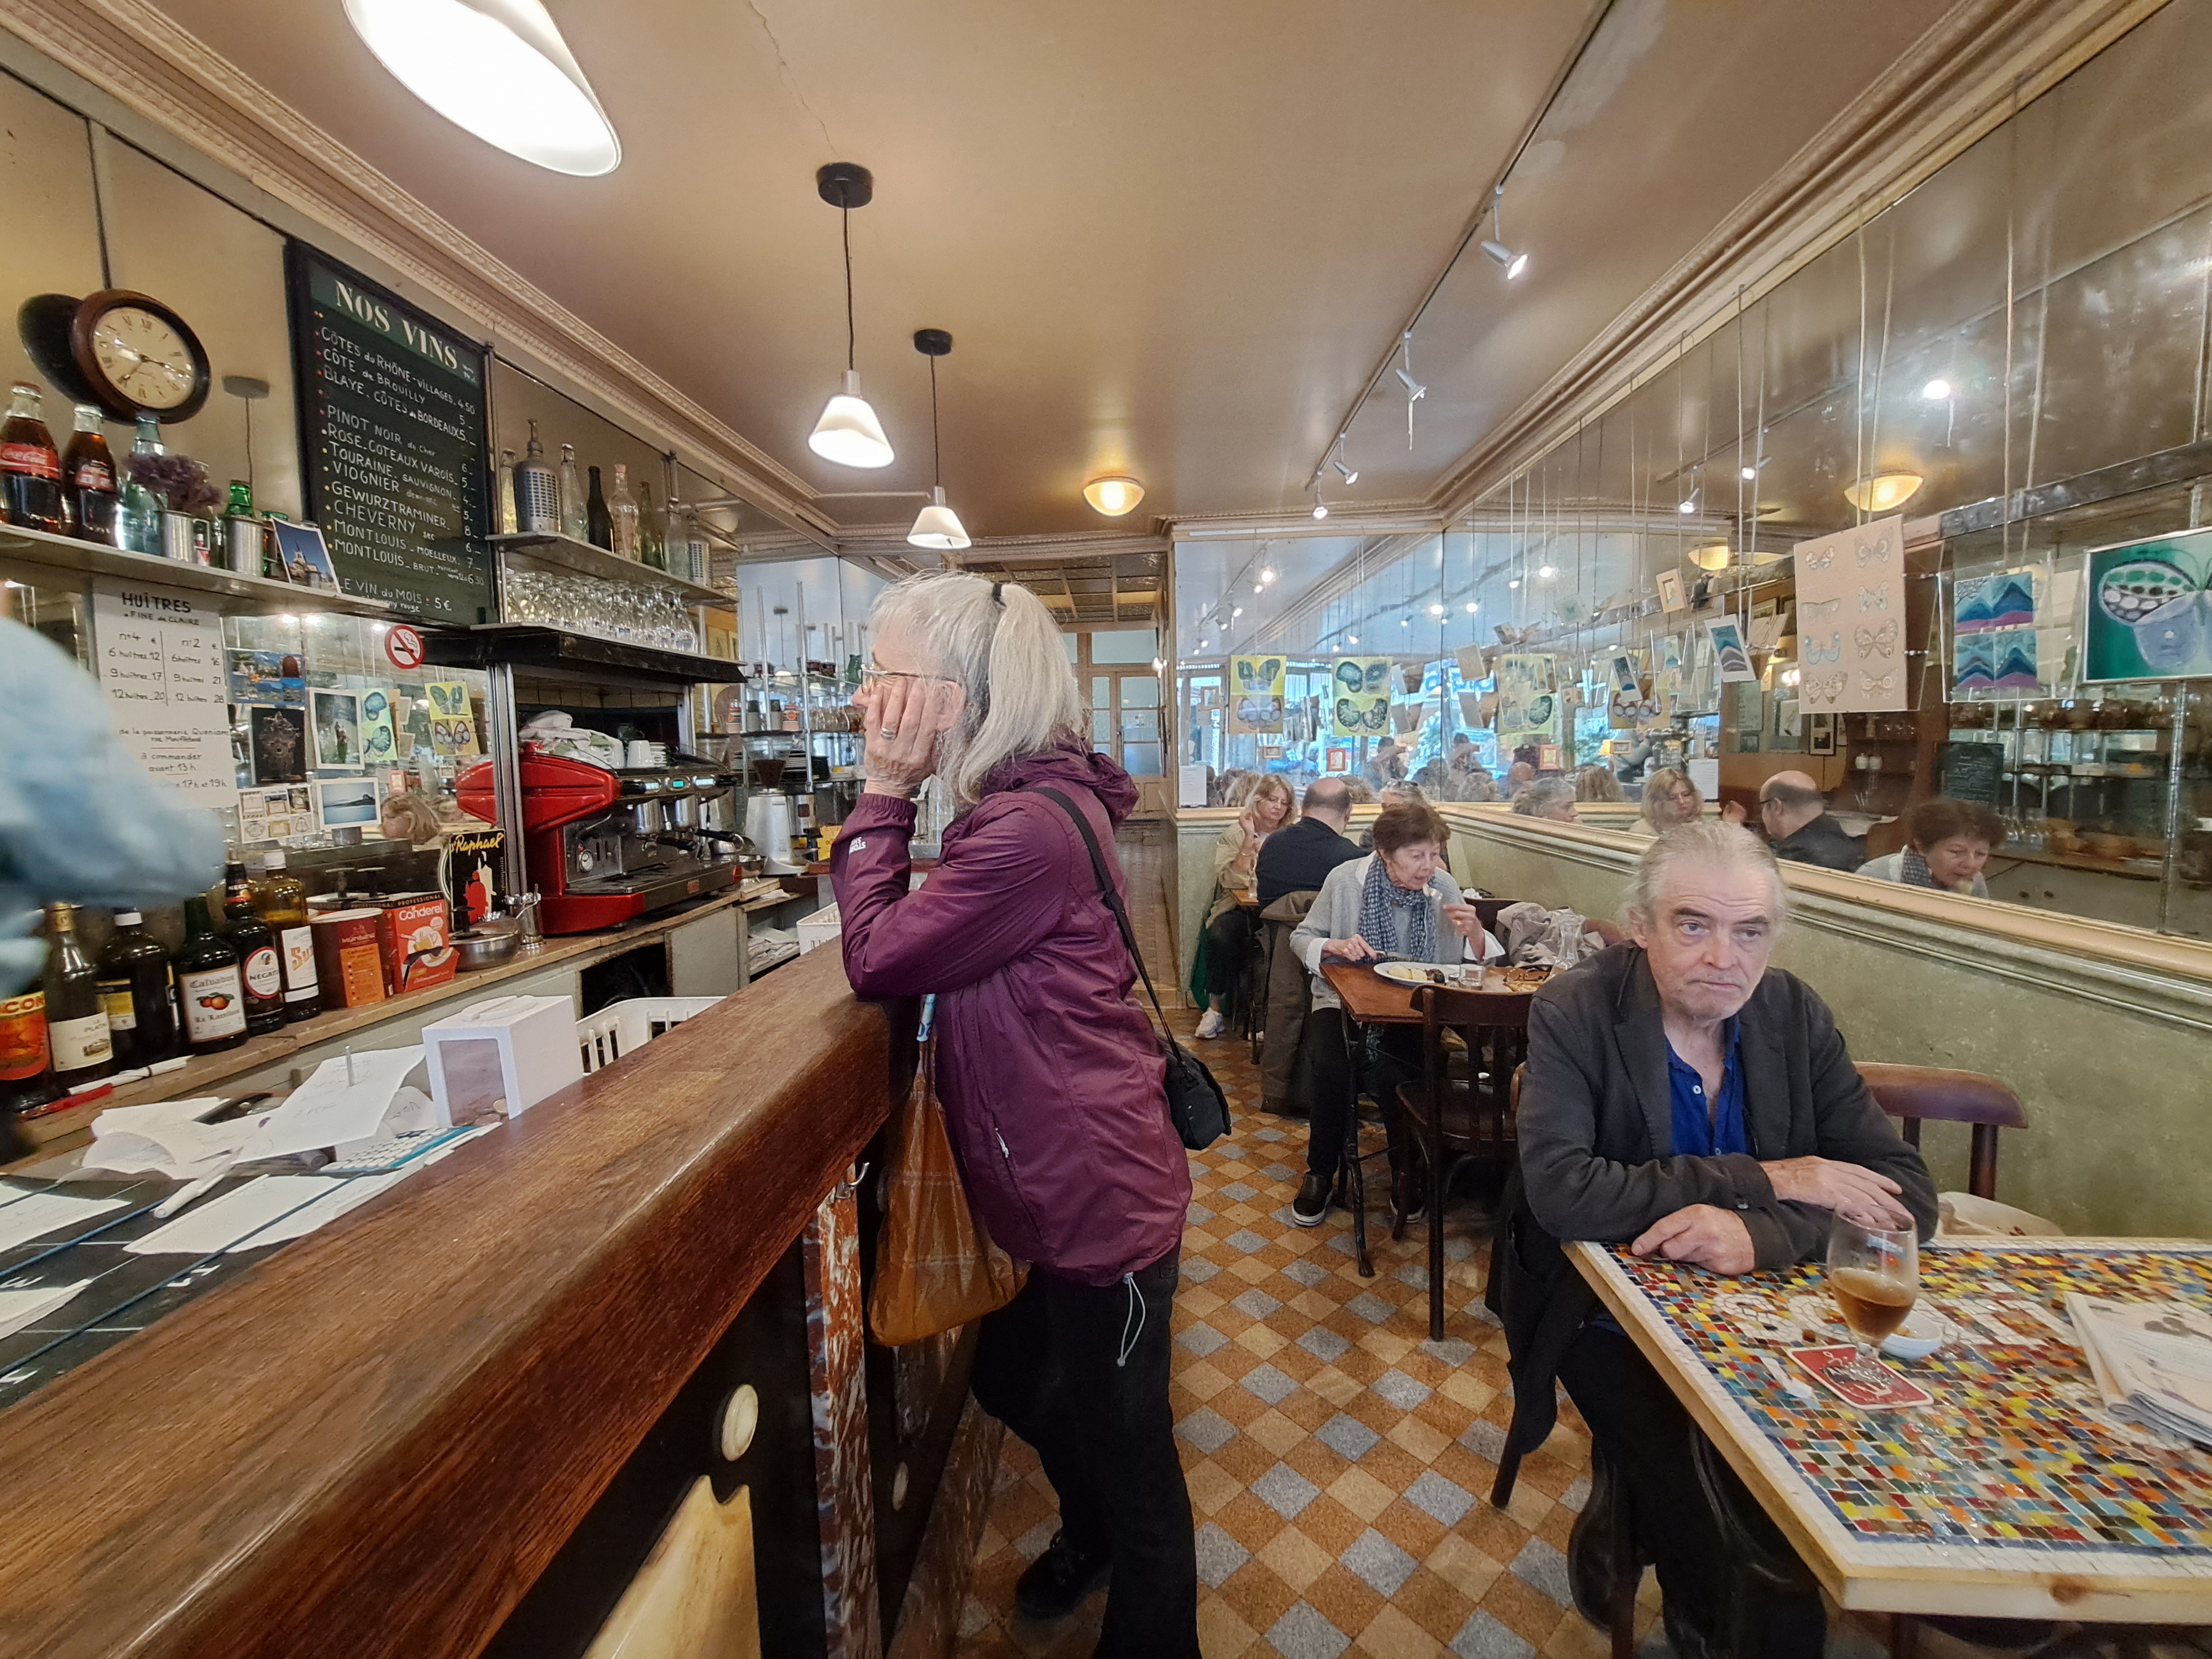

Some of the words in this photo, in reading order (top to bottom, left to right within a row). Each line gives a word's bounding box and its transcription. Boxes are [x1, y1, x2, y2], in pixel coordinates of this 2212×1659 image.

[335, 280, 390, 331] NOS
[401, 319, 457, 369] VINS
[324, 348, 356, 372] CÔTE
[362, 371, 374, 381] de
[377, 373, 425, 404] BROUILLY
[328, 405, 369, 430] PINOT
[375, 425, 402, 444] NOIR
[418, 410, 458, 436] BORDEAUX
[333, 460, 399, 493] VIOGNIER
[335, 500, 415, 533] CHEVERNY
[334, 519, 406, 549] MONTLOUIS
[334, 539, 404, 566] MONTLOUIS
[356, 580, 377, 594] VIN
[382, 588, 393, 597] du
[131, 611, 154, 620] FINE
[108, 648, 116, 657] 6
[149, 652, 160, 660] 12
[111, 669, 118, 677] 9
[152, 672, 162, 681] 17
[174, 674, 181, 682] 9
[112, 689, 123, 698] 12
[176, 693, 184, 701] 12
[214, 695, 224, 703] 28
[398, 894, 441, 906] PROFESSIONAL
[399, 904, 442, 921] Canderel
[290, 945, 314, 971] Suz
